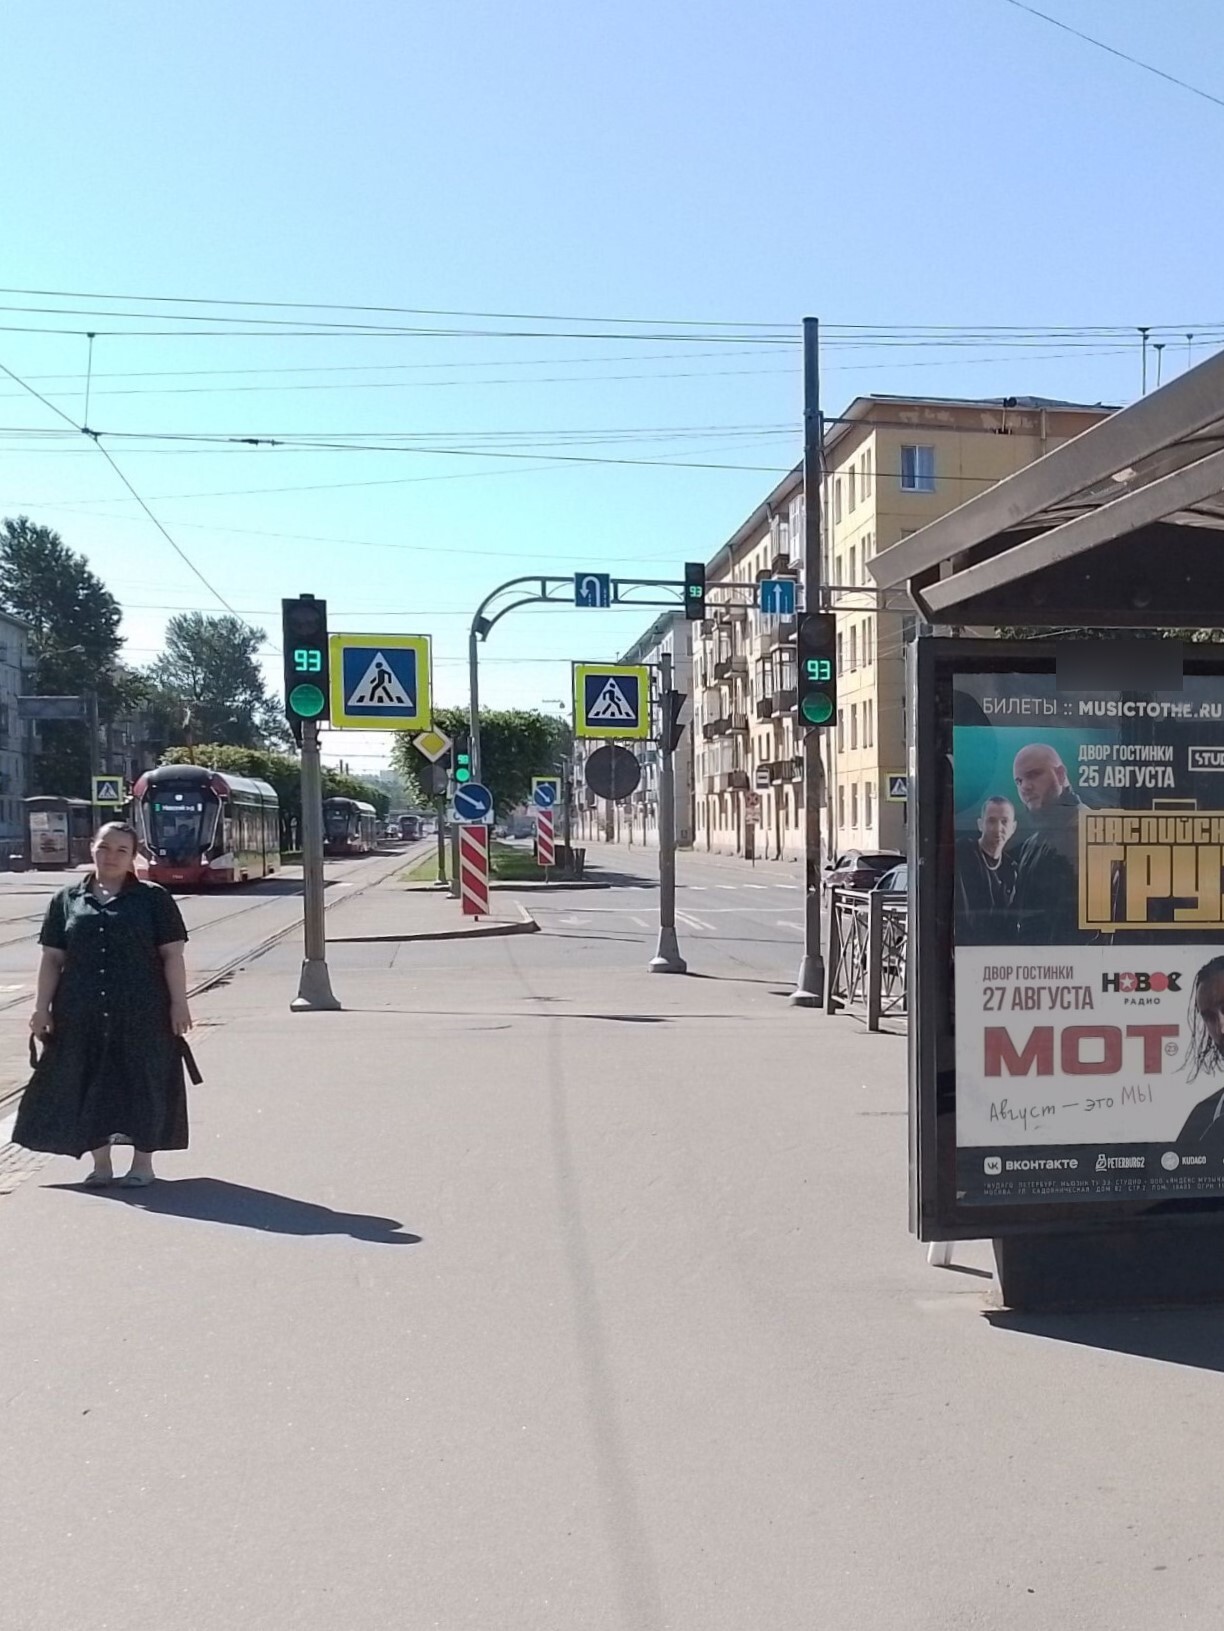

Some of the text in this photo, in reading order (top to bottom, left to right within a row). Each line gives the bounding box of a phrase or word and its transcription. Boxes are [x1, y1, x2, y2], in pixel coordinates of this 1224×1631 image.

[689, 586, 702, 598] 93
[294, 649, 321, 672] 93
[807, 659, 831, 681] 93
[982, 697, 1057, 715] БИЛЕТЫ
[1078, 700, 1222, 718] MUSICTOTHE.RU
[1078, 744, 1174, 762] ДВОР ГОСТИНКИ
[1078, 765, 1175, 788] 25 АВГУСТА
[982, 965, 1074, 982] ДВОР ГОСТИНКИ
[982, 986, 1095, 1012] 27 АВГУСТА
[1124, 997, 1161, 1006] РАДИО
[983, 1023, 1180, 1078] МОТ
[989, 1098, 1056, 1131] Август
[1084, 1097, 1114, 1112] это
